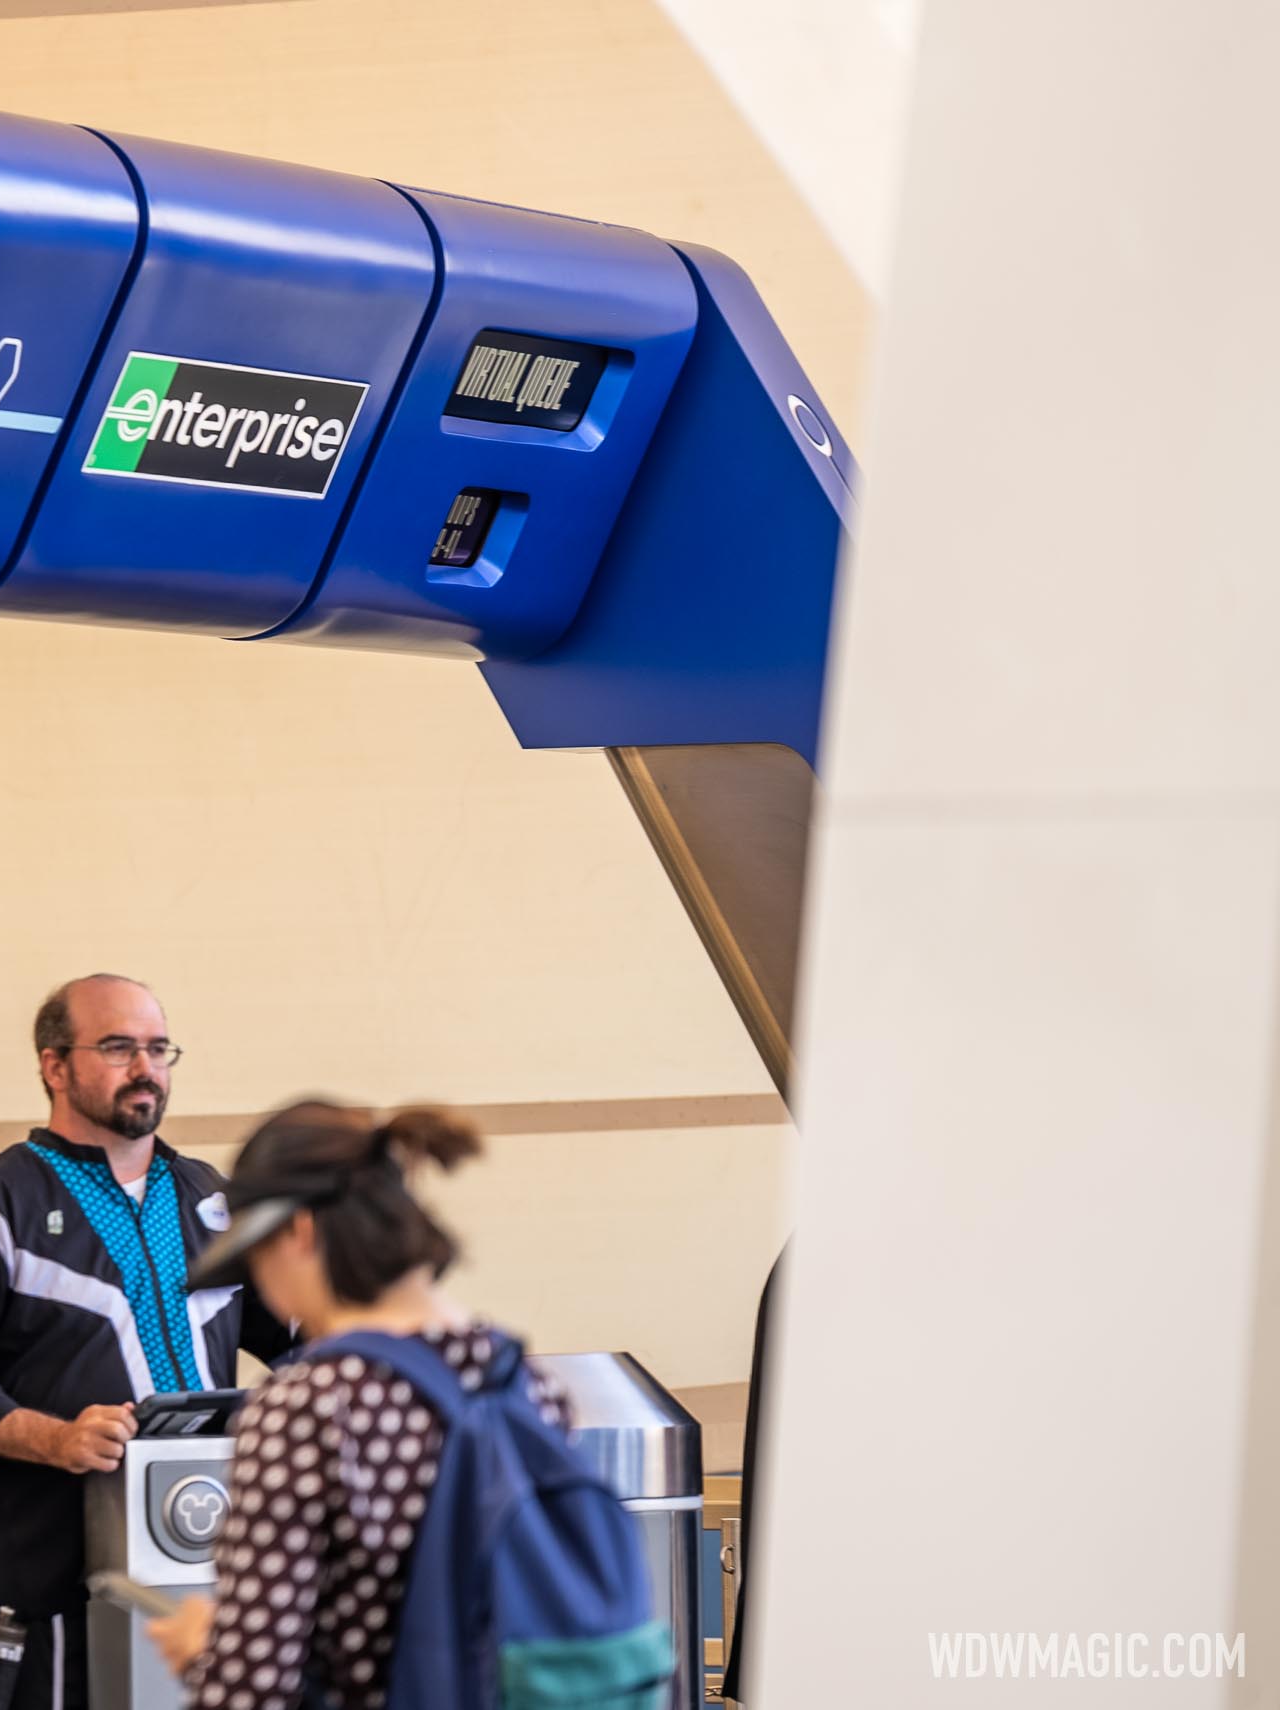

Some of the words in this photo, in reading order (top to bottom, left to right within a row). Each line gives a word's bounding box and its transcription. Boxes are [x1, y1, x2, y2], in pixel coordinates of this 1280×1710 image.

[456, 345, 532, 403] VIRTUAL
[515, 355, 581, 412] QUEUE
[106, 388, 346, 468] enterprise
